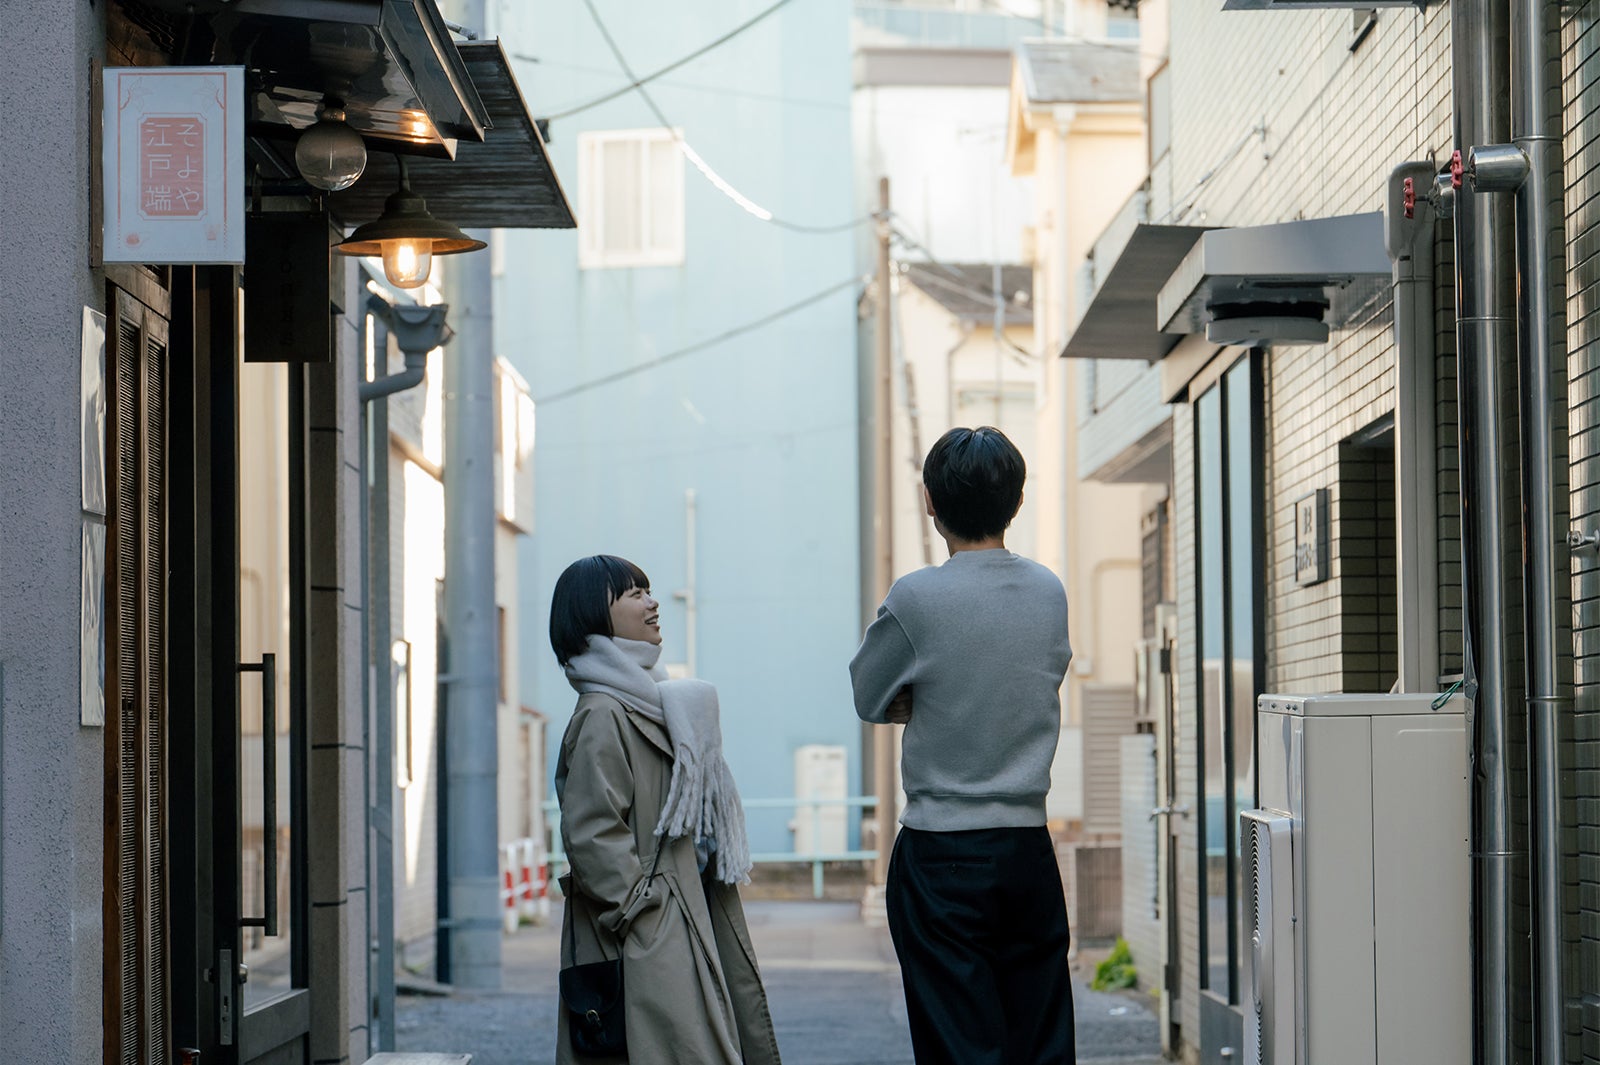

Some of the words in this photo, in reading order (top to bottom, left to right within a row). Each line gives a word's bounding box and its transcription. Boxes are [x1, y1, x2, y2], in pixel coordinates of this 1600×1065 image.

[144, 122, 173, 211] 江戸端
[176, 124, 200, 210] そよや
